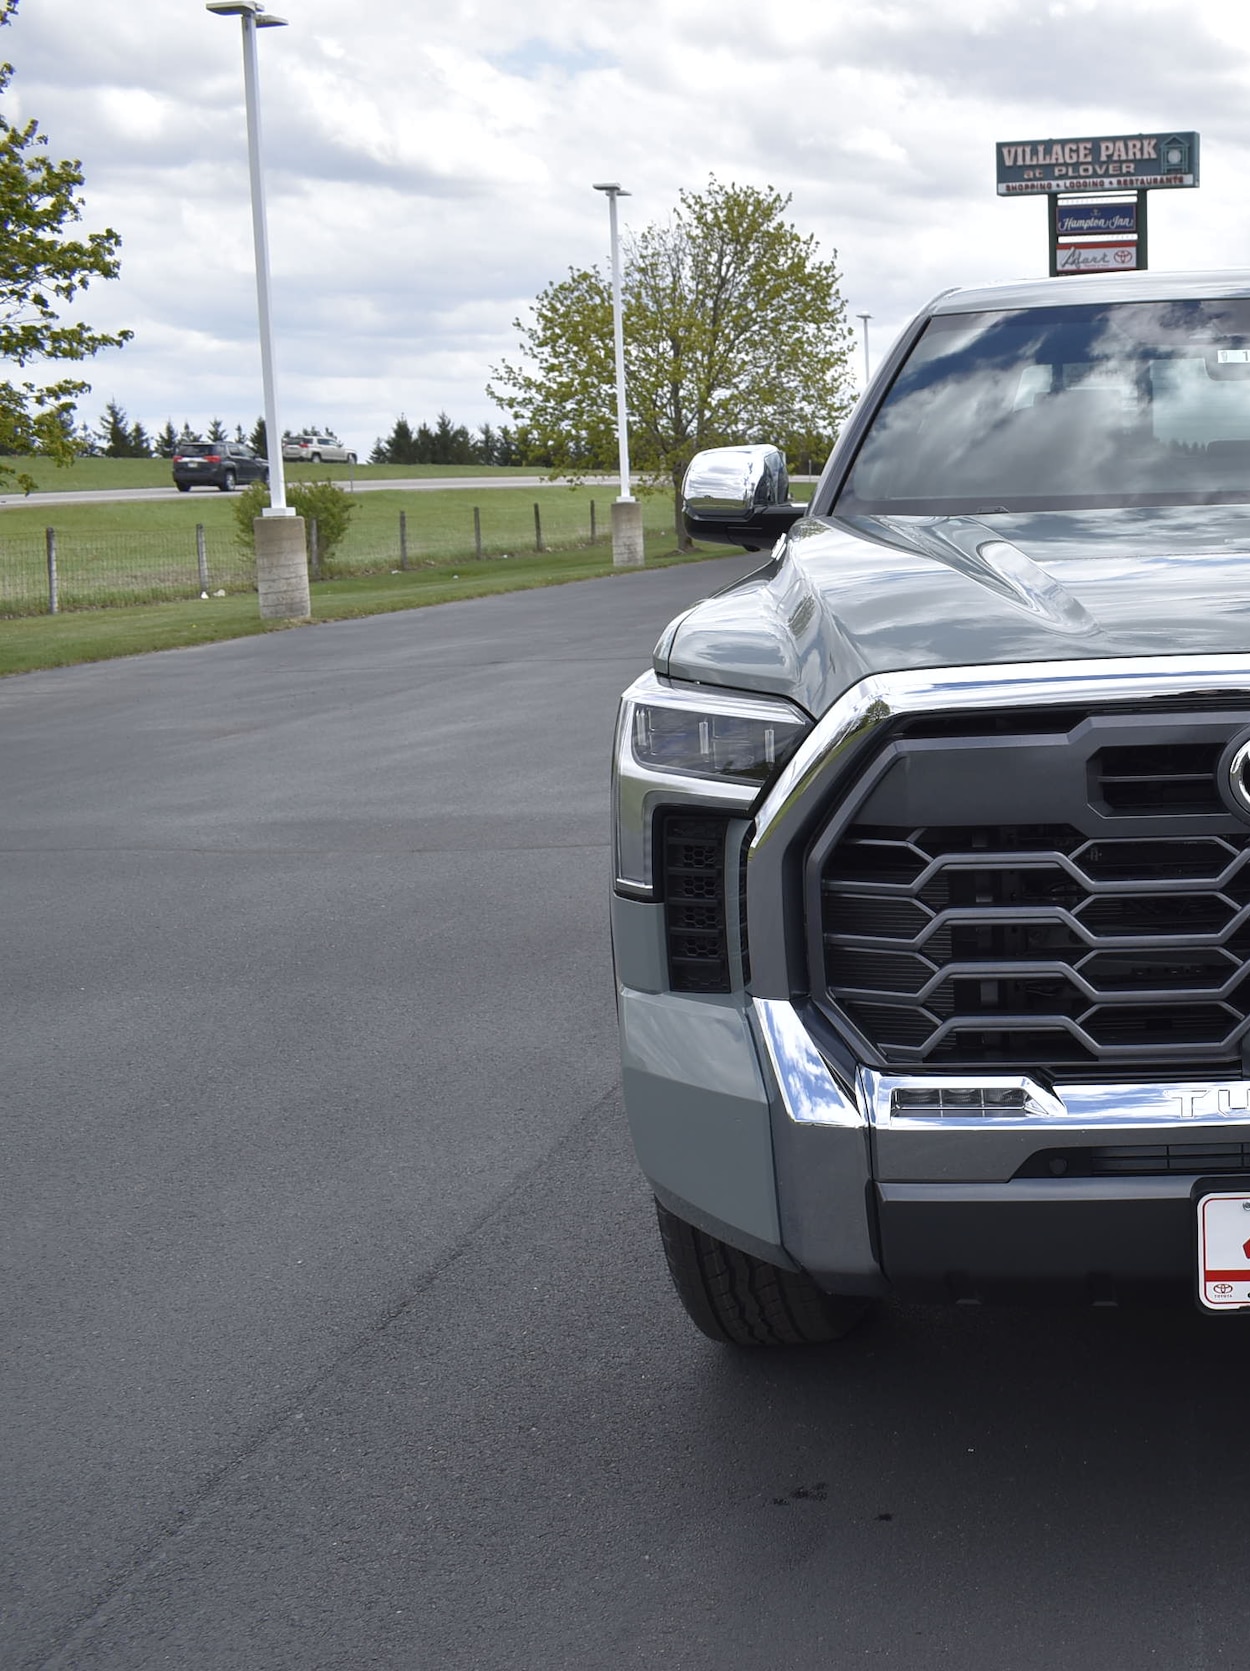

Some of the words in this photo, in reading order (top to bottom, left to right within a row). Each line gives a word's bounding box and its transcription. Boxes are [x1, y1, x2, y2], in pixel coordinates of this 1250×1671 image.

[1002, 142, 1092, 166] VILLAGE
[1100, 138, 1157, 161] PARK
[1023, 168, 1043, 179] at
[1054, 163, 1135, 177] PLOVER
[1005, 182, 1052, 192] SHOPPING
[1063, 179, 1105, 189] LODGING
[1116, 175, 1184, 186] RESTAURANTS
[1059, 217, 1108, 230] Hampton
[1109, 216, 1133, 228] Inn
